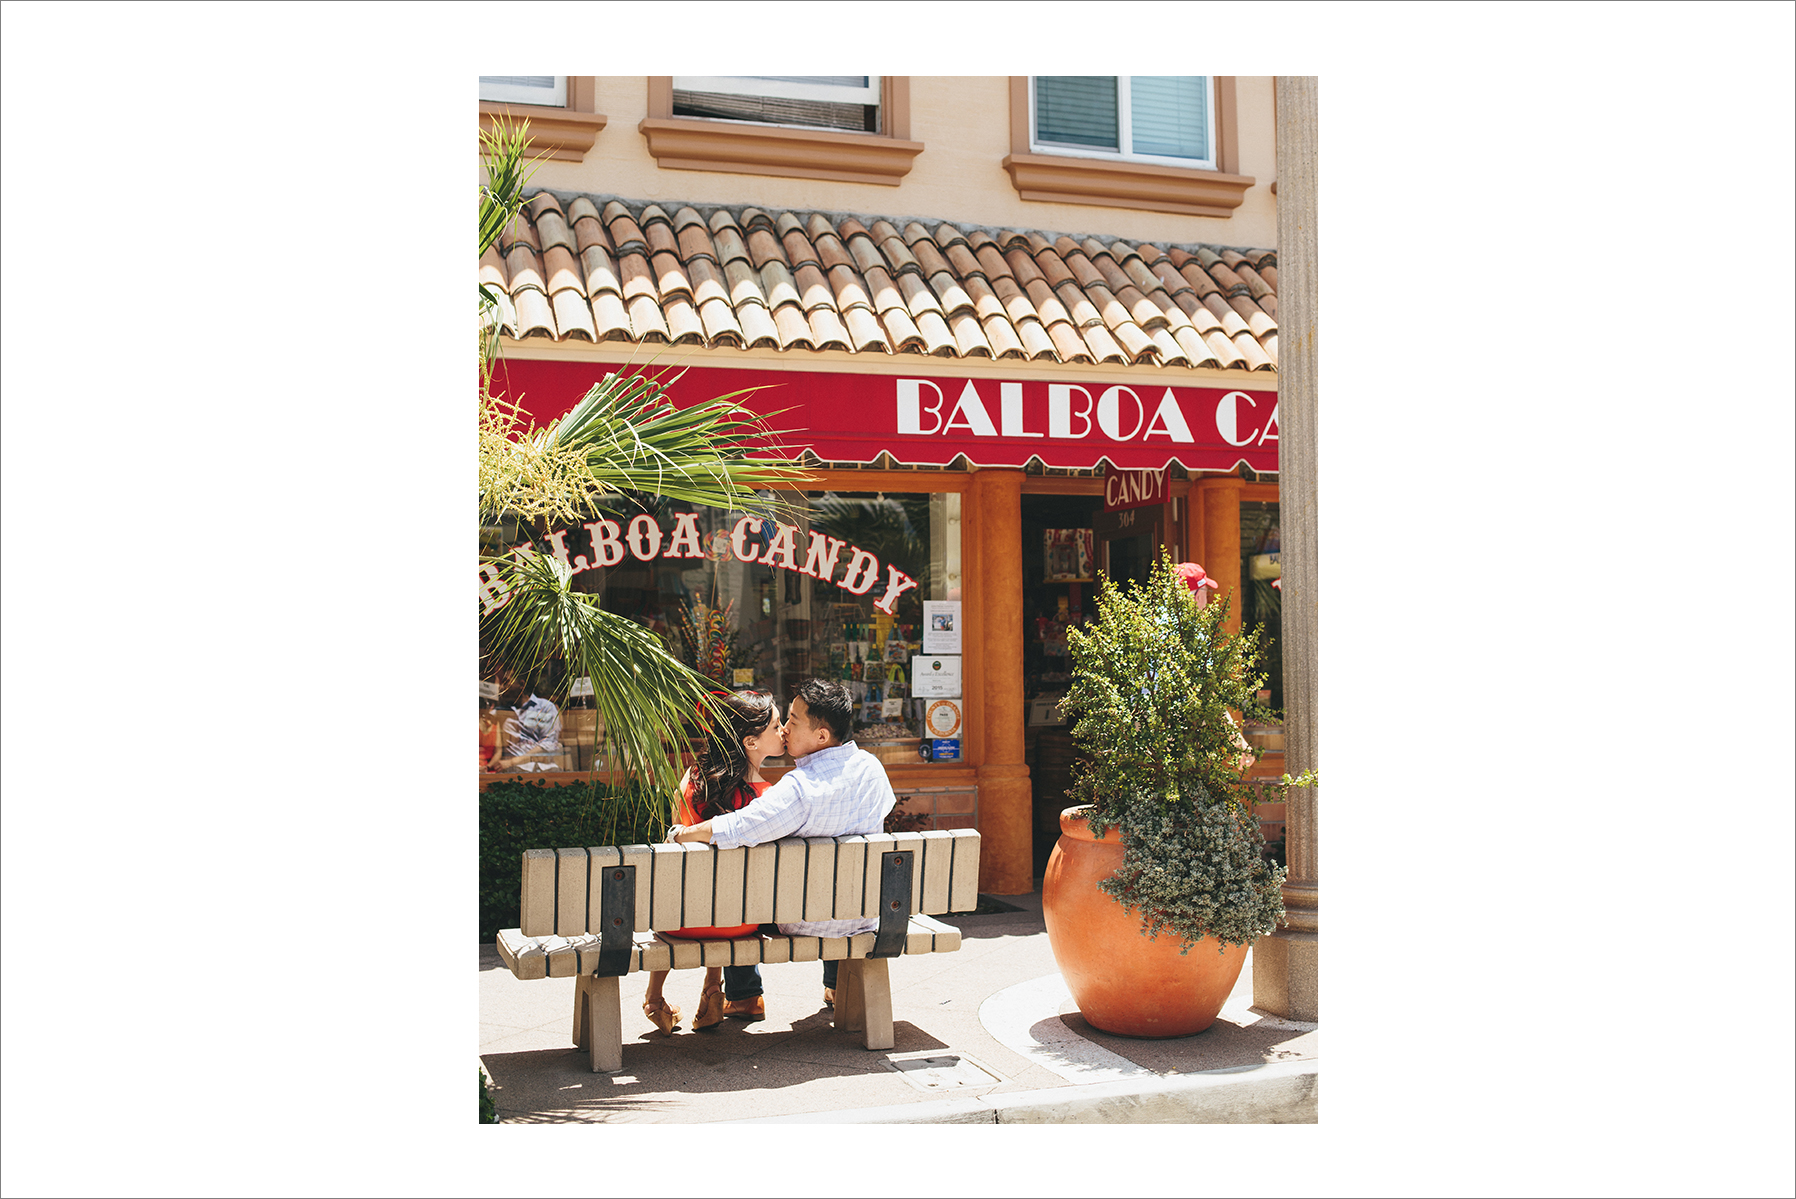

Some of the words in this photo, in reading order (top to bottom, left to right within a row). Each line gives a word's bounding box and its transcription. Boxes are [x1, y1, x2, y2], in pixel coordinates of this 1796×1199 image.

[896, 378, 1195, 443] BALBOA
[1106, 469, 1165, 507] CANDY
[1119, 509, 1135, 529] 304
[729, 515, 919, 616] CANDY
